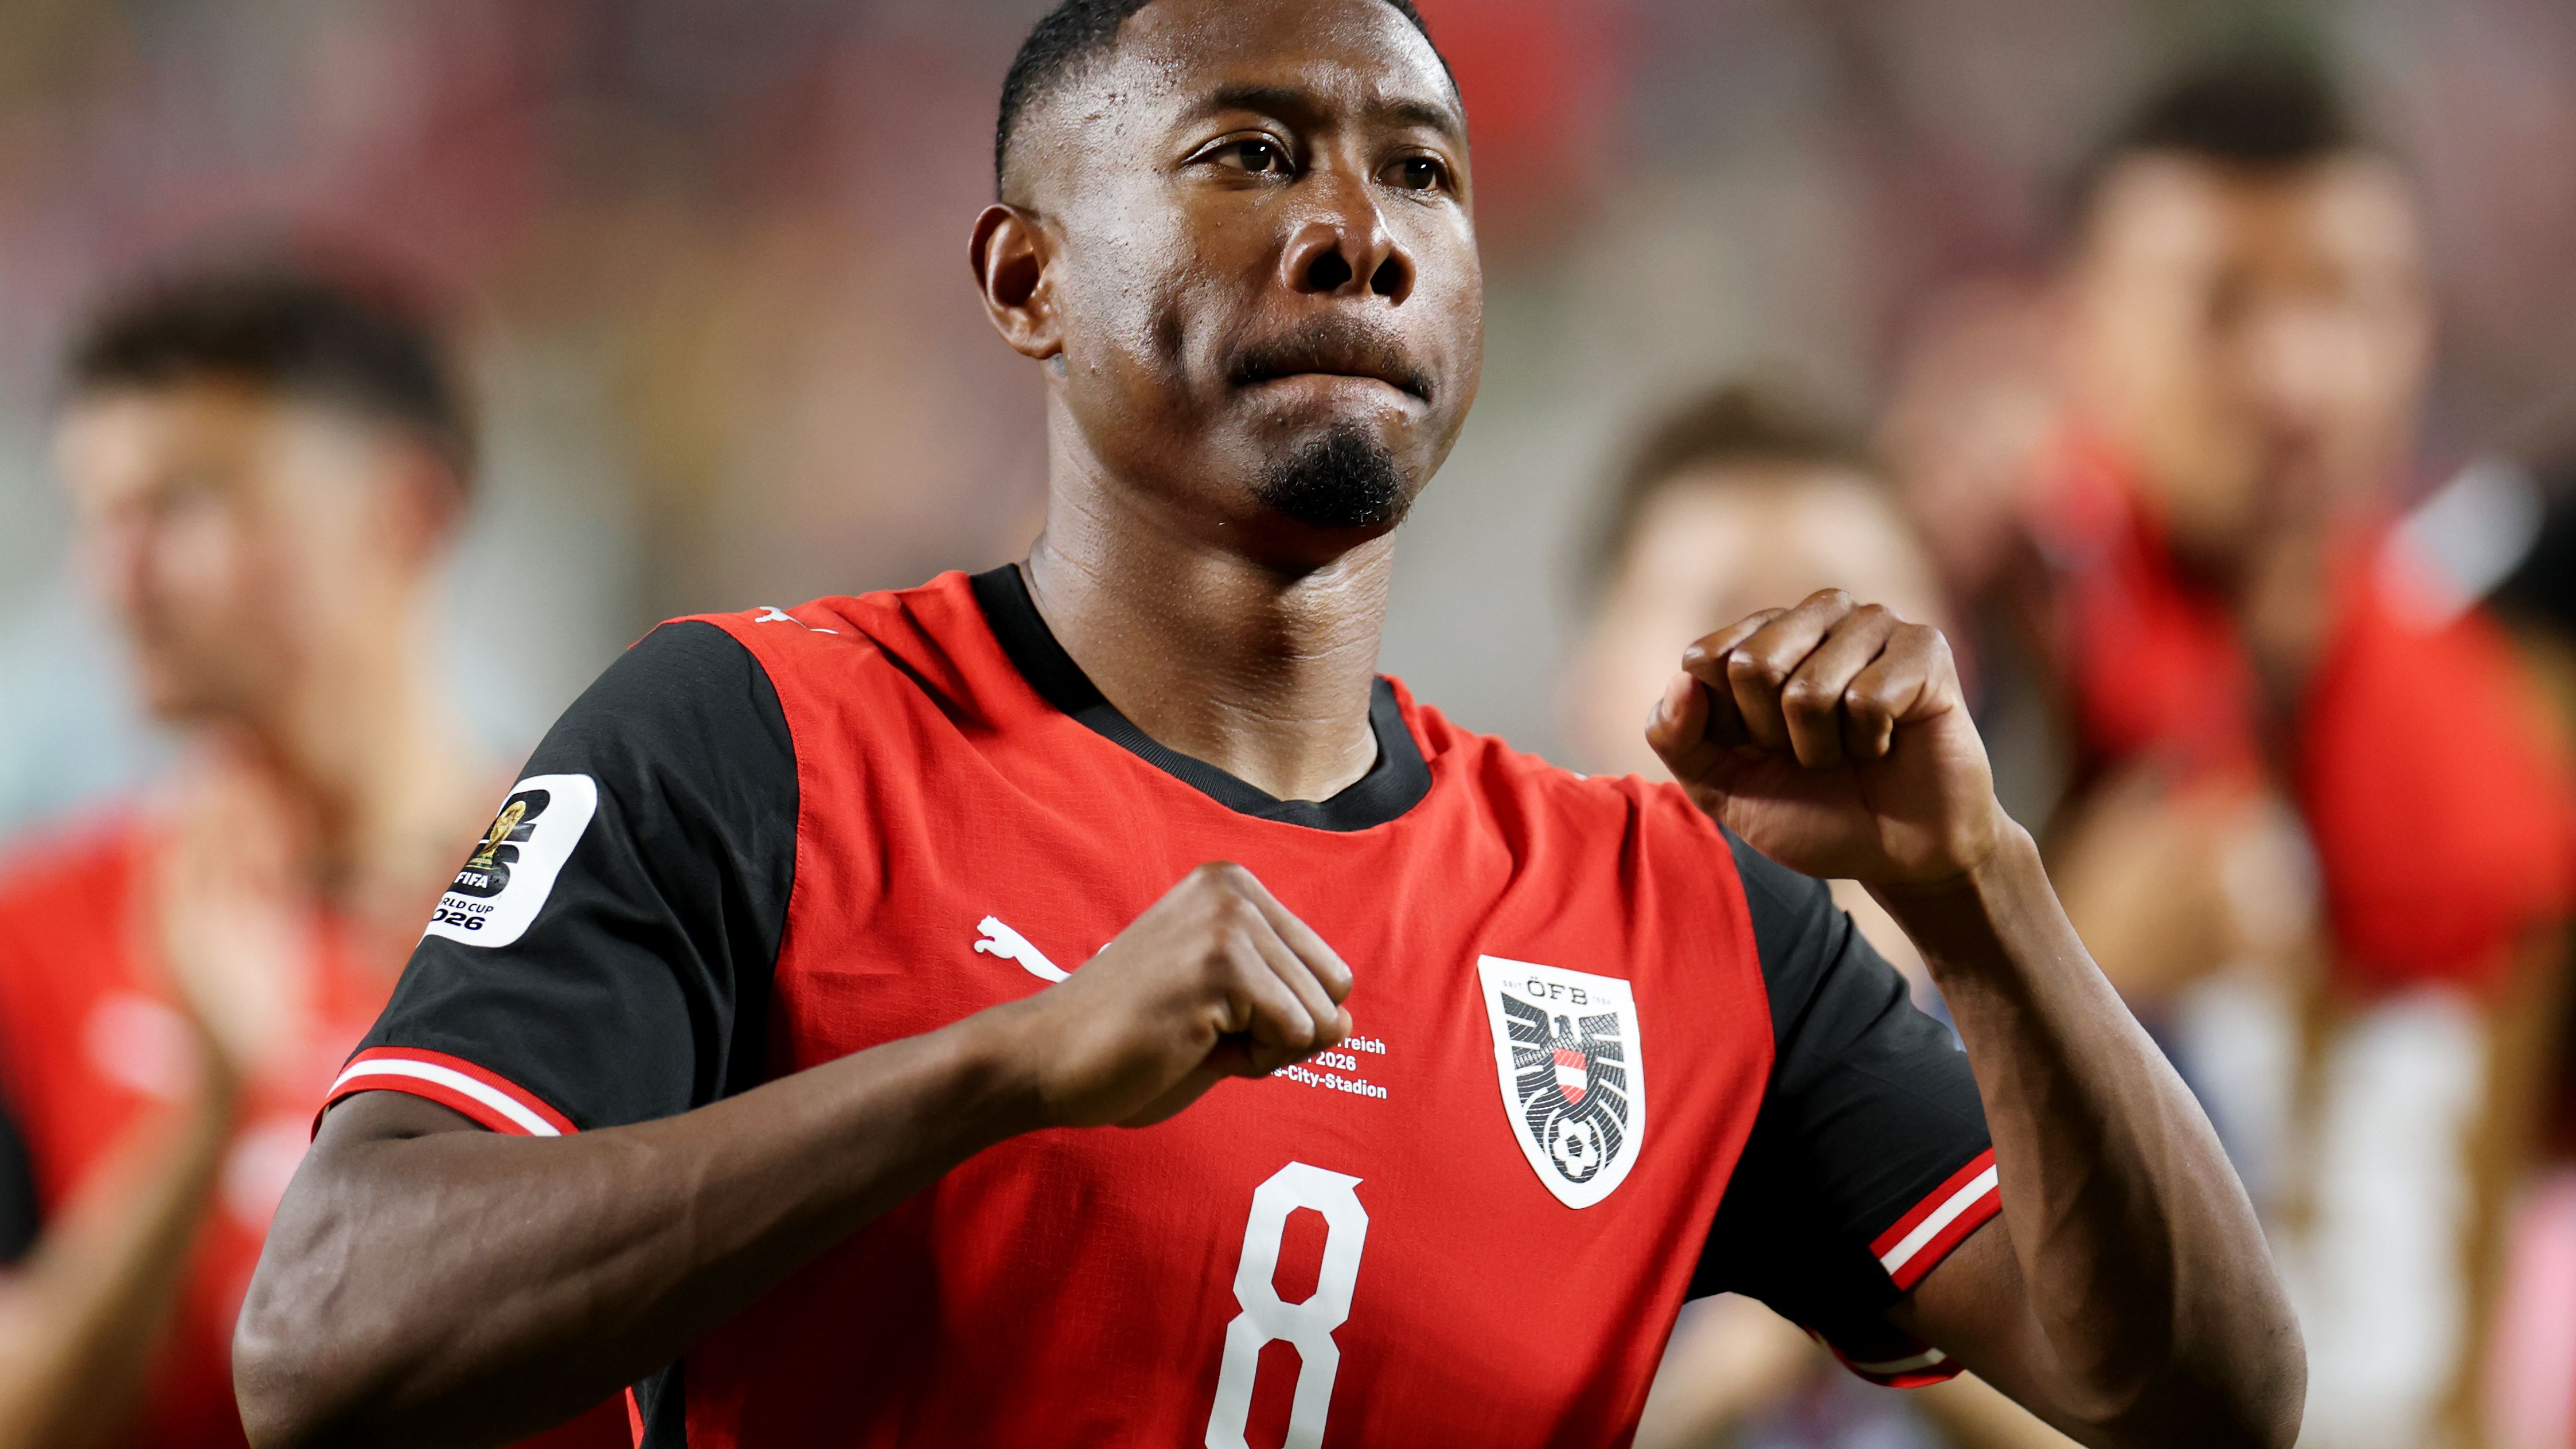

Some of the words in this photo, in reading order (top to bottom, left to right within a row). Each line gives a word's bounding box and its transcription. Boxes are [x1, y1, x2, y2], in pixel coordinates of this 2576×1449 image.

[454, 871, 489, 888] FIFA
[440, 897, 467, 909] RLD
[467, 903, 494, 913] CUP
[431, 908, 486, 931] 026
[1527, 976, 1588, 1005] ÖFB
[1337, 1036, 1386, 1055] reich
[1316, 1050, 1357, 1071] 2026
[1270, 1064, 1388, 1099] s-City-Stadion
[1204, 1161, 1369, 1449] 8
